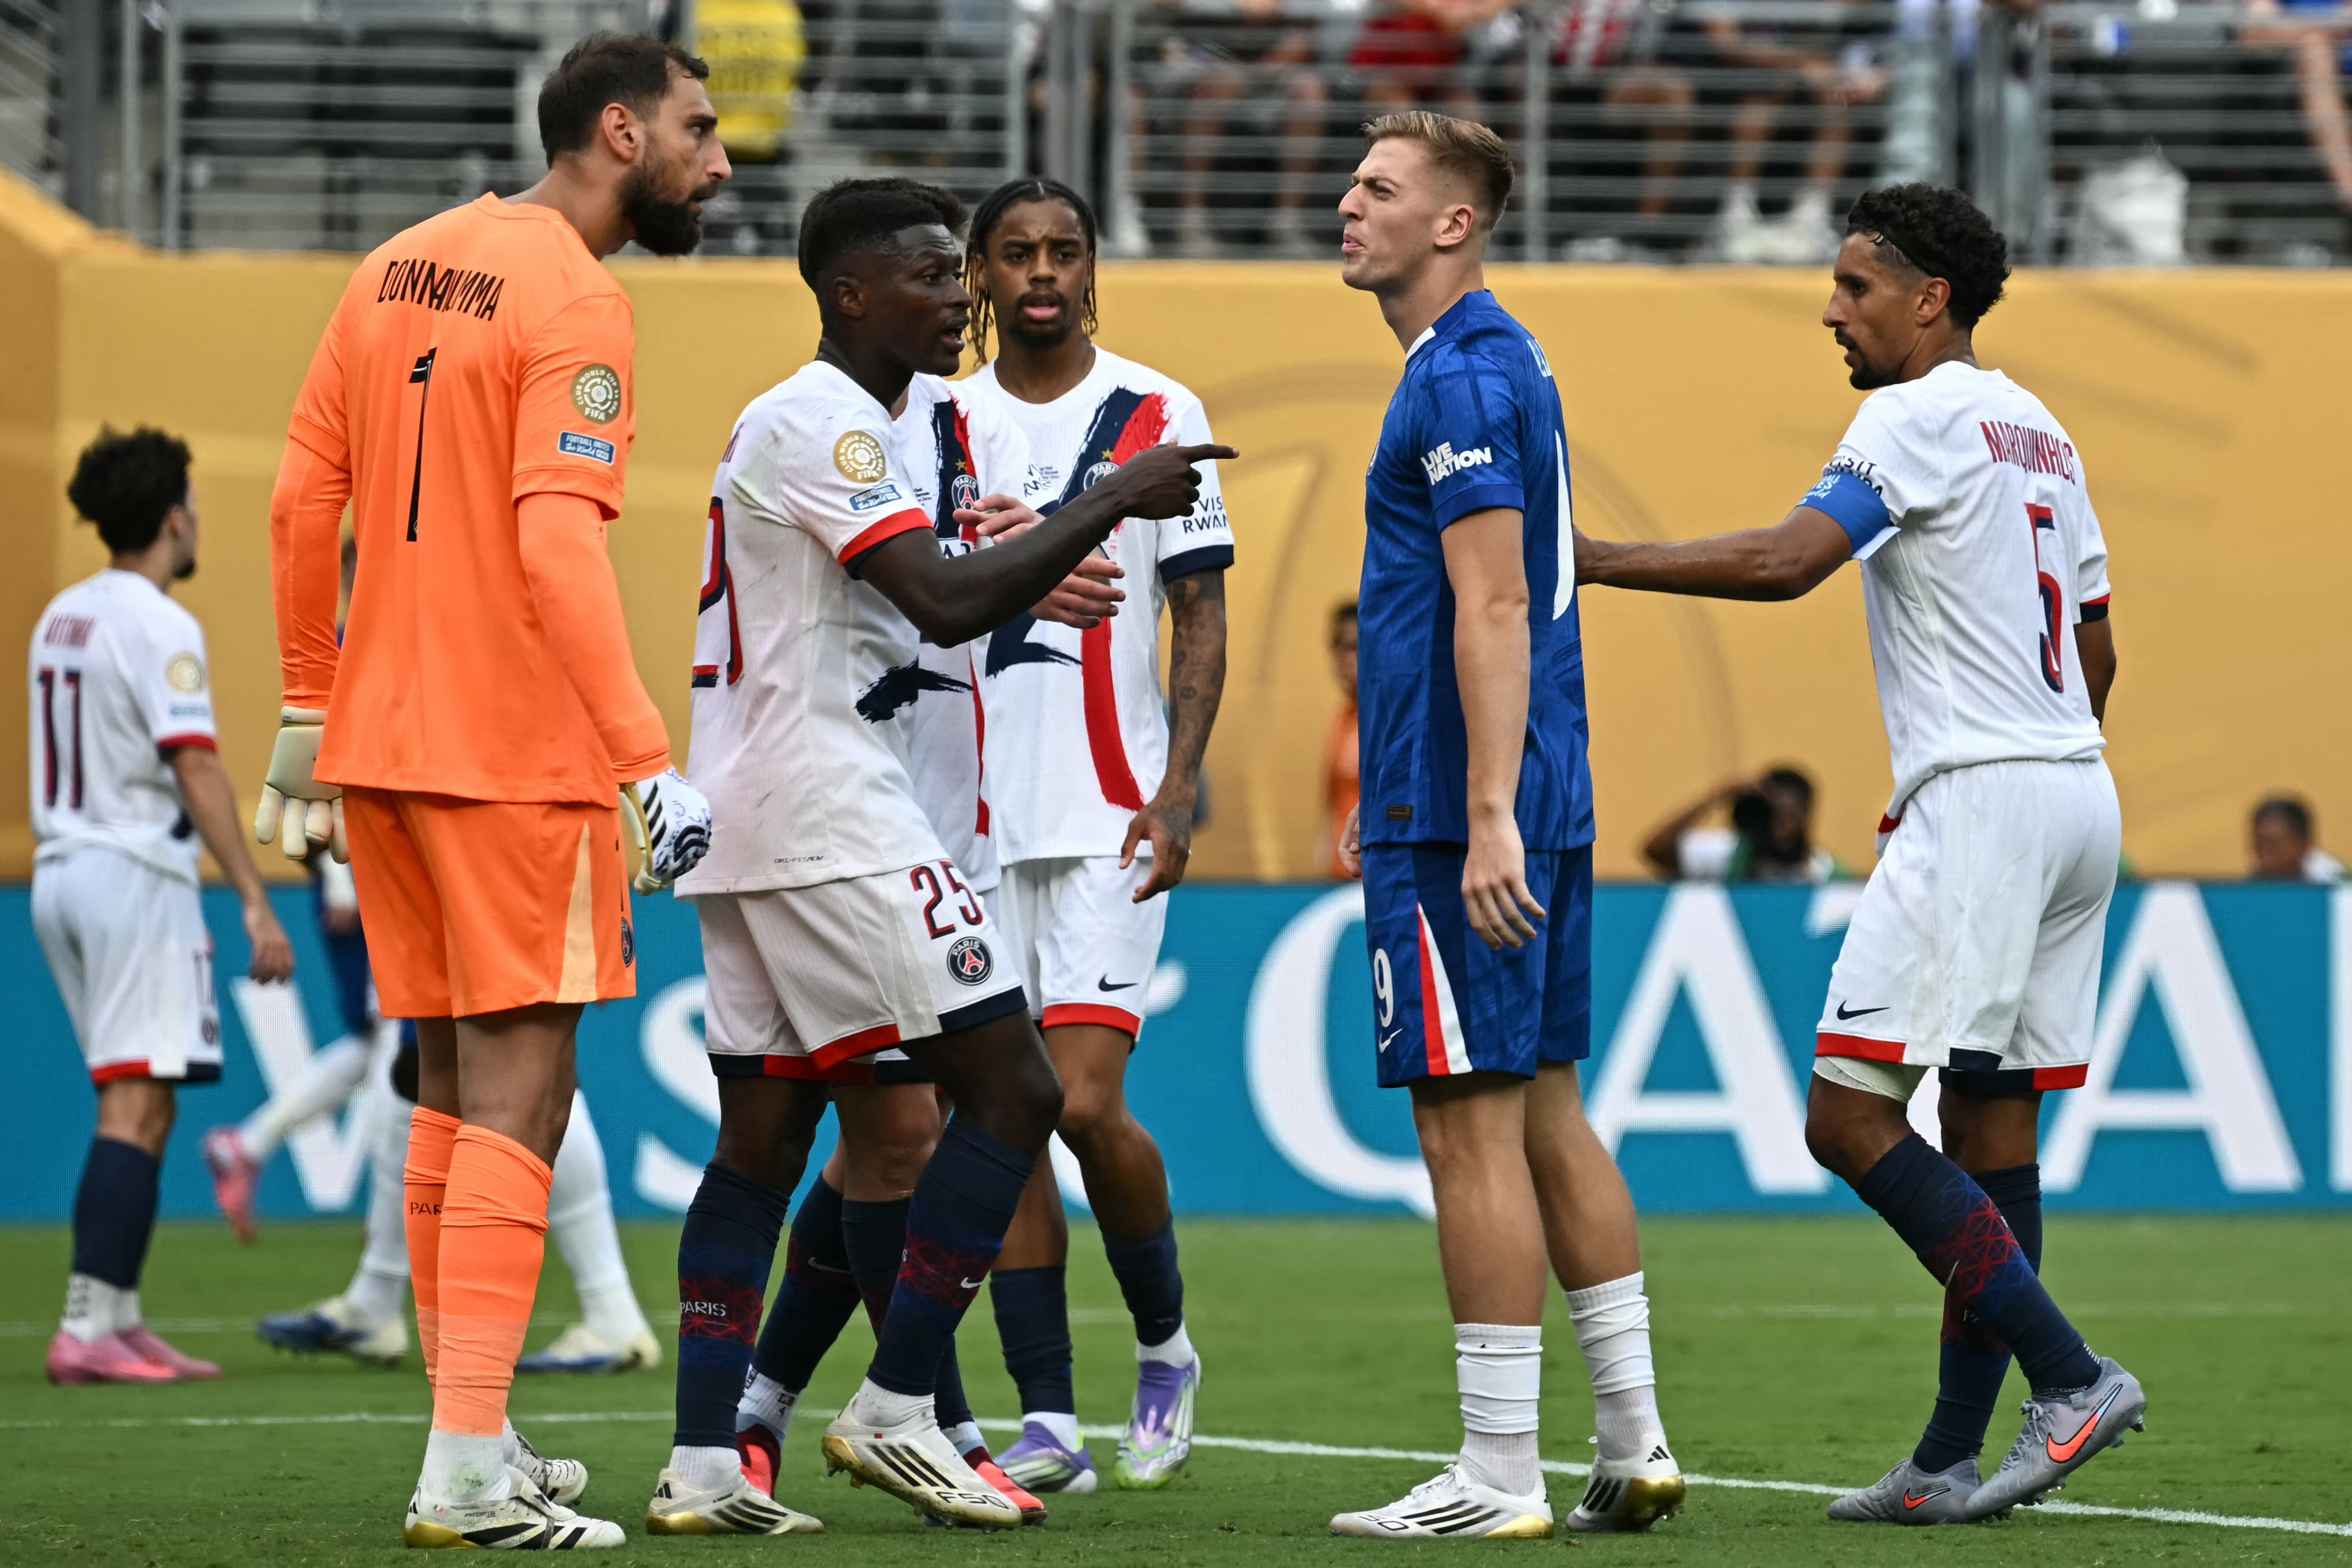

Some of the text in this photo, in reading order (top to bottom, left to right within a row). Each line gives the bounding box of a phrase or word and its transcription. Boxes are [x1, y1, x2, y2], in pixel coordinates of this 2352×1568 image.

[579, 369, 605, 383] WORLD
[585, 407, 605, 421] FIFA
[406, 347, 438, 542] 1
[839, 435, 860, 453] WORLD
[1979, 420, 2076, 486] MARQUINHOS
[1420, 441, 1454, 472] LIVE
[857, 469, 879, 479] FIFA
[1428, 446, 1492, 486] NATION
[955, 477, 977, 489] PARIS
[1199, 496, 1223, 512] VIS
[1182, 513, 1227, 534] RWAN
[2024, 502, 2065, 694] 5
[909, 860, 983, 941] 25
[952, 940, 981, 956] PARIS
[1374, 948, 1394, 1028] 9
[410, 1201, 442, 1215] PAR
[680, 1301, 727, 1317] PARIS
[935, 1491, 1009, 1510] F50
